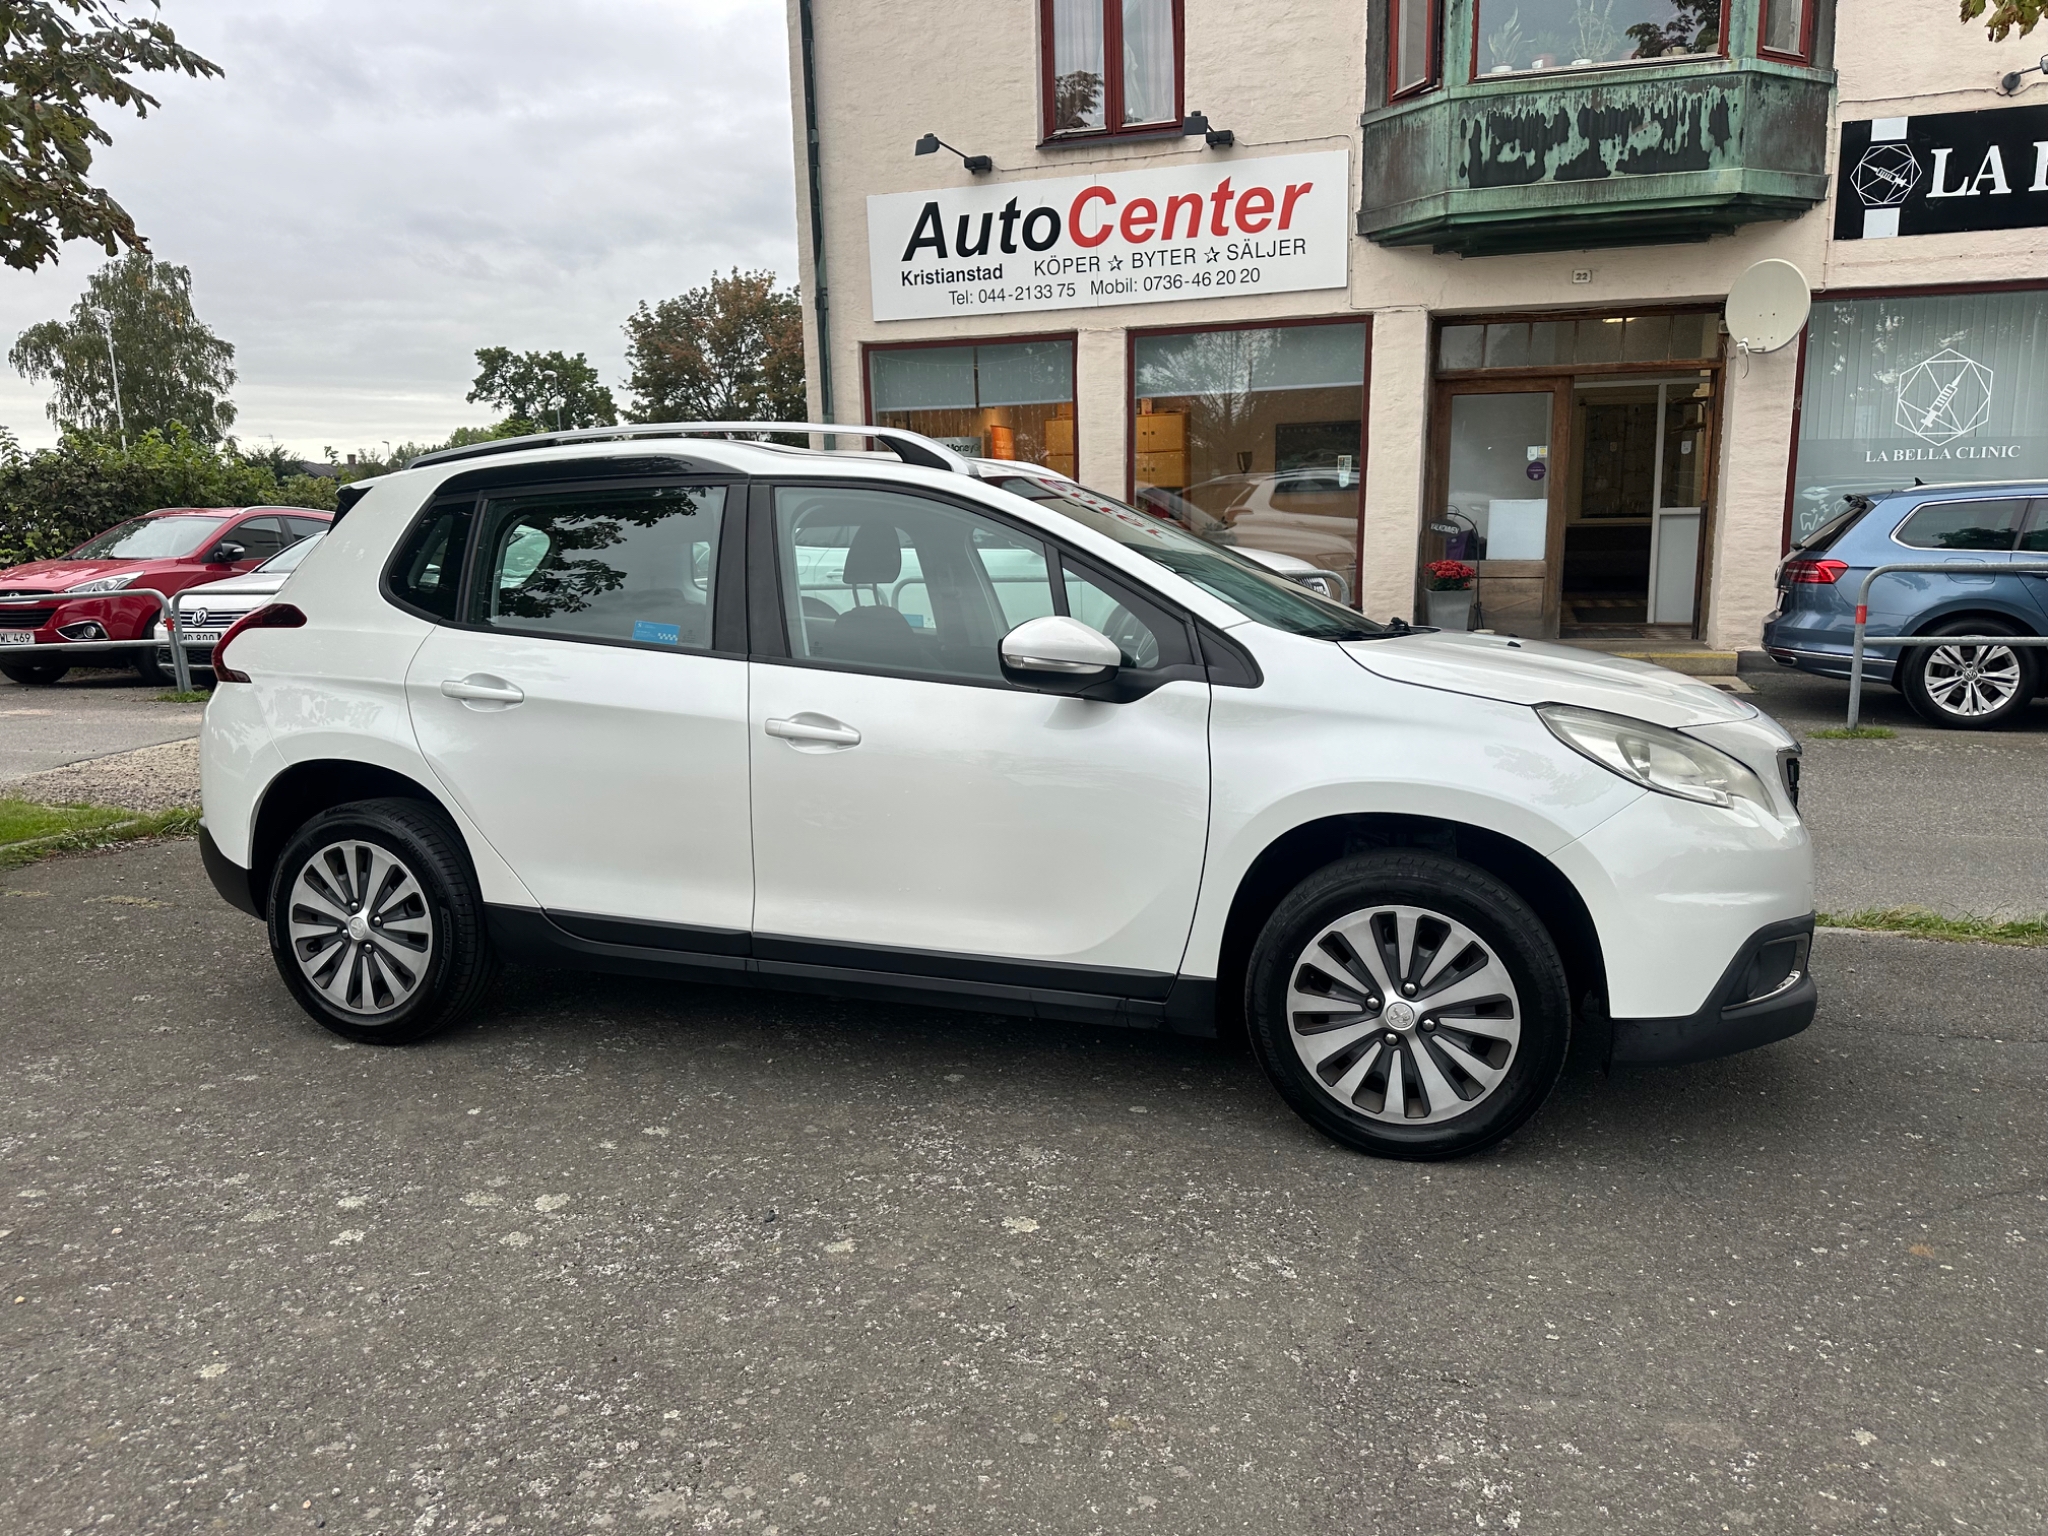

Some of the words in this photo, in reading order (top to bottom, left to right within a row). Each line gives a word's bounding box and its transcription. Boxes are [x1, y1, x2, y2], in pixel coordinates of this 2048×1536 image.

[1926, 144, 2012, 198] LA
[901, 175, 1314, 262] AutoCenter
[1034, 255, 1100, 277] KÖPER
[1132, 248, 1197, 269] BYTER
[1226, 238, 1306, 261] SÄLJER
[901, 263, 1004, 287] Kristianstad
[1575, 272, 1588, 281] 22
[948, 290, 974, 305] Tel:
[1090, 277, 1138, 296] Mobil:
[1865, 450, 1888, 463] LA
[1893, 447, 1951, 461] BELLA
[1956, 445, 2021, 460] CLINIC
[13, 632, 31, 643] 469
